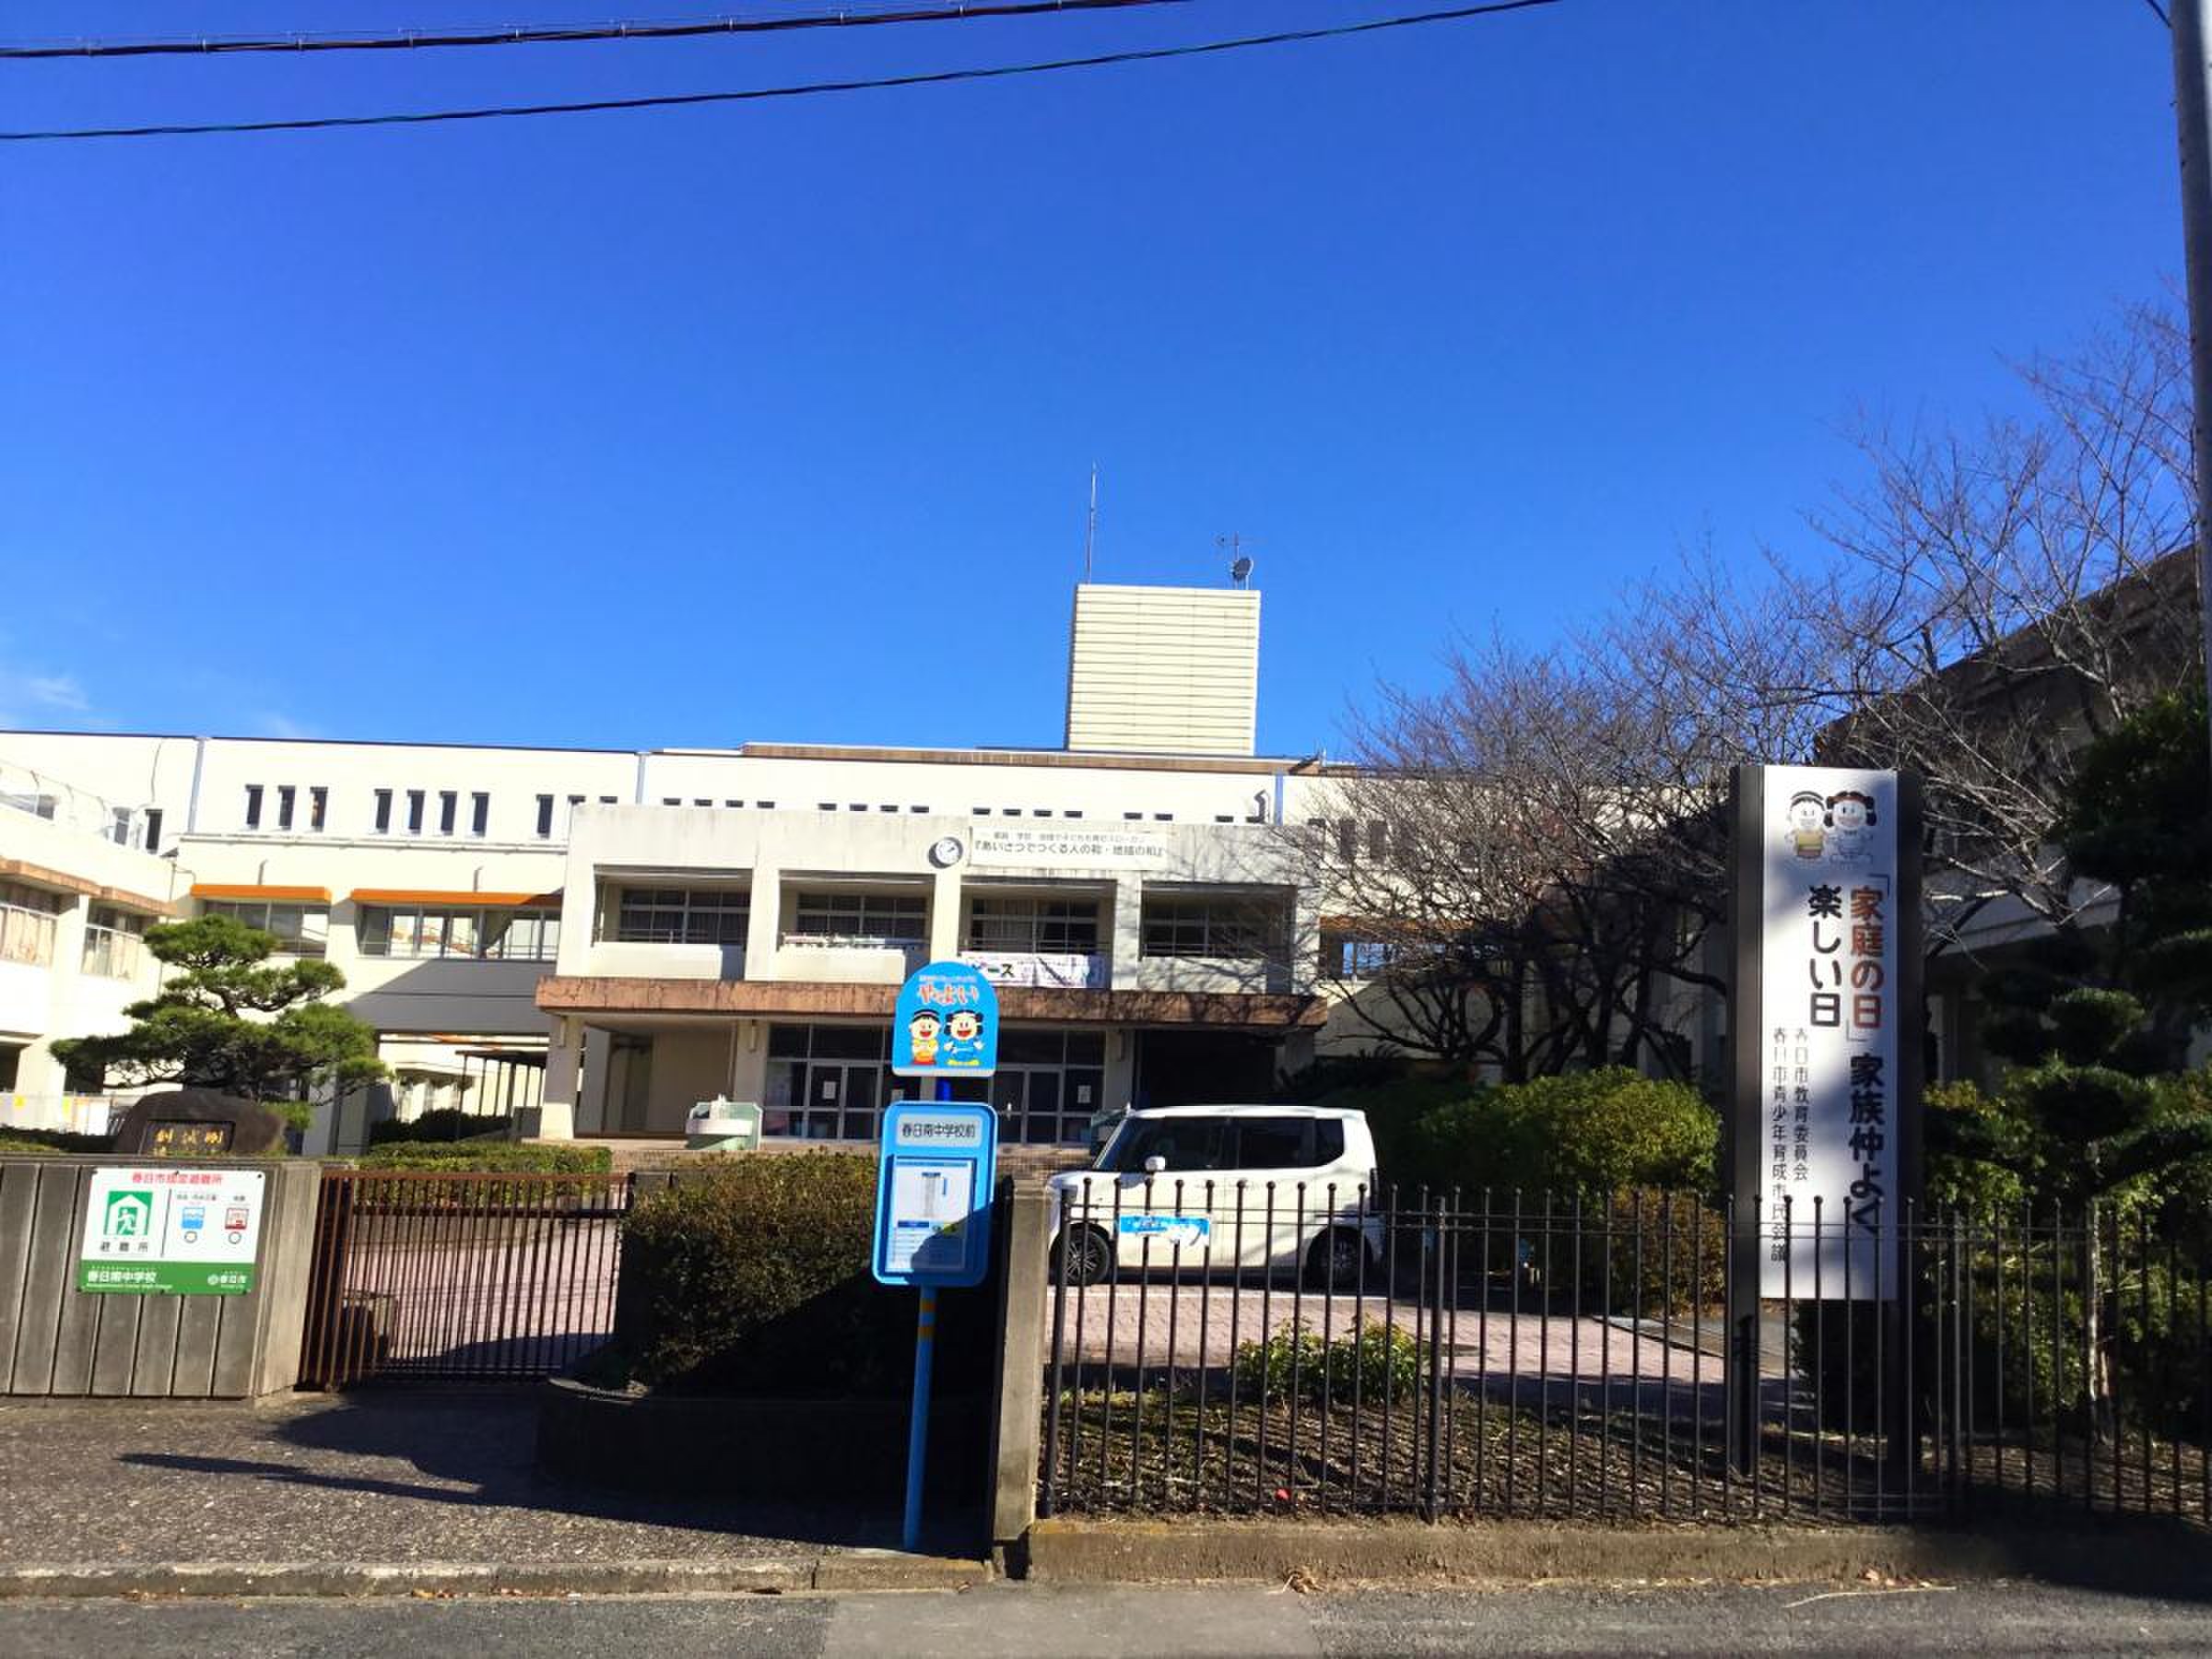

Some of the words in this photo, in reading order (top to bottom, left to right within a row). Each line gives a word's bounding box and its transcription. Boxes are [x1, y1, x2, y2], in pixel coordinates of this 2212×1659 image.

[1807, 884, 1842, 1028] 楽しい日
[902, 1123, 975, 1138] 春日南中学校前
